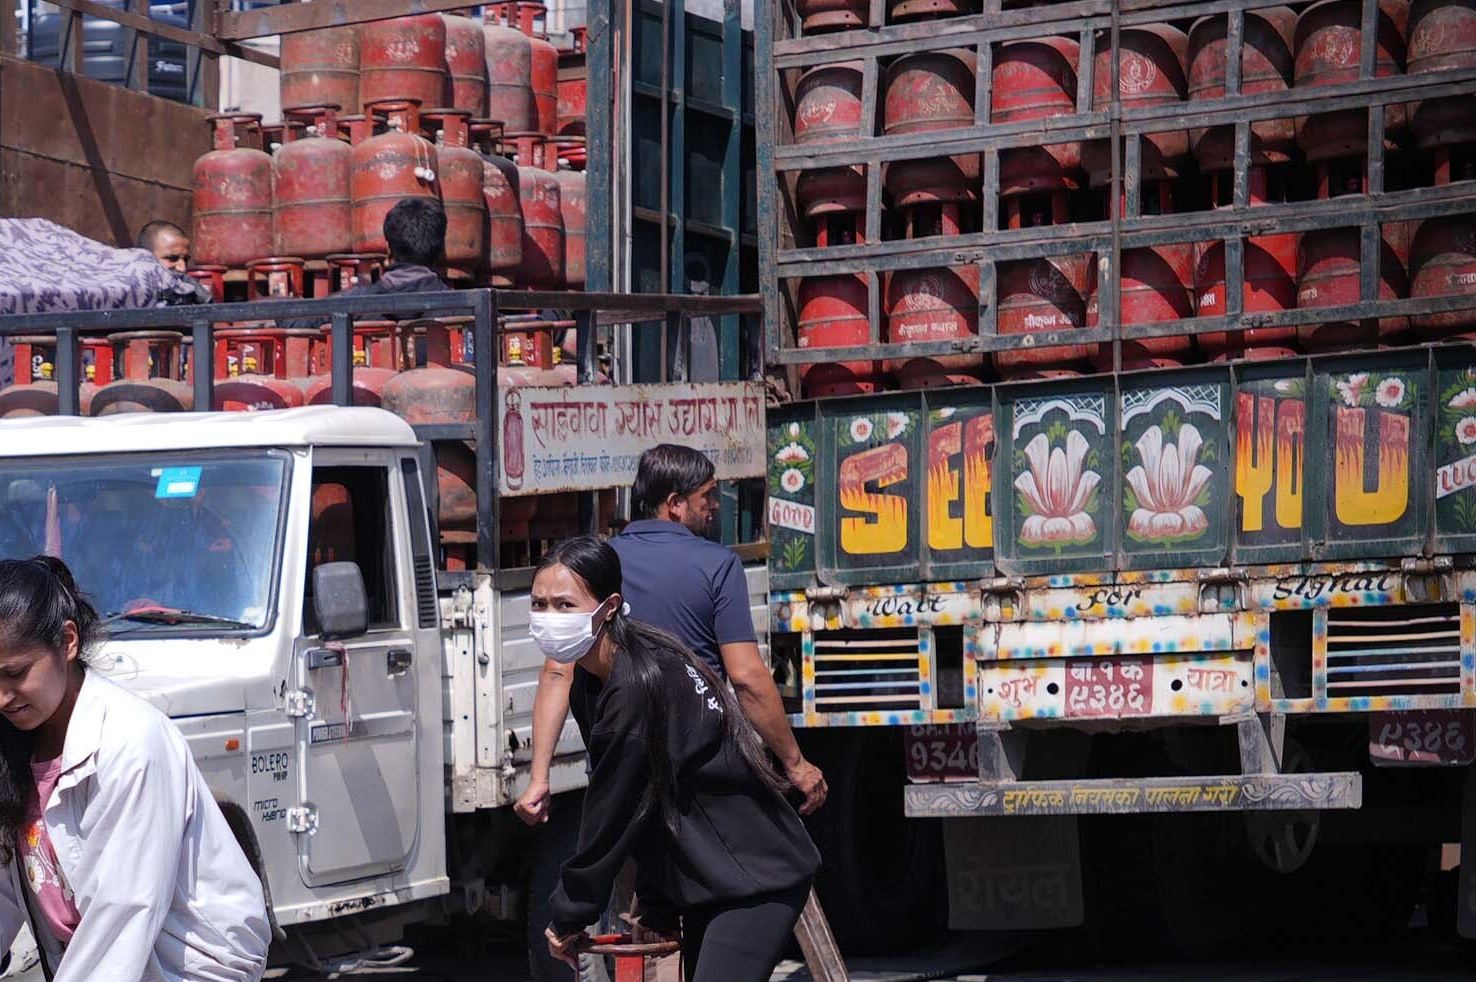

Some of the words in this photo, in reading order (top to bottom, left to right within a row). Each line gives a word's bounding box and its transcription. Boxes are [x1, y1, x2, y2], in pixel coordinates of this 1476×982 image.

[840, 413, 994, 555] SEE
[1235, 391, 1411, 532] YOU
[1076, 588, 1142, 612] for
[997, 675, 1042, 707] शुभ
[1186, 668, 1237, 693] यात्रा
[252, 752, 288, 774] BOLERO
